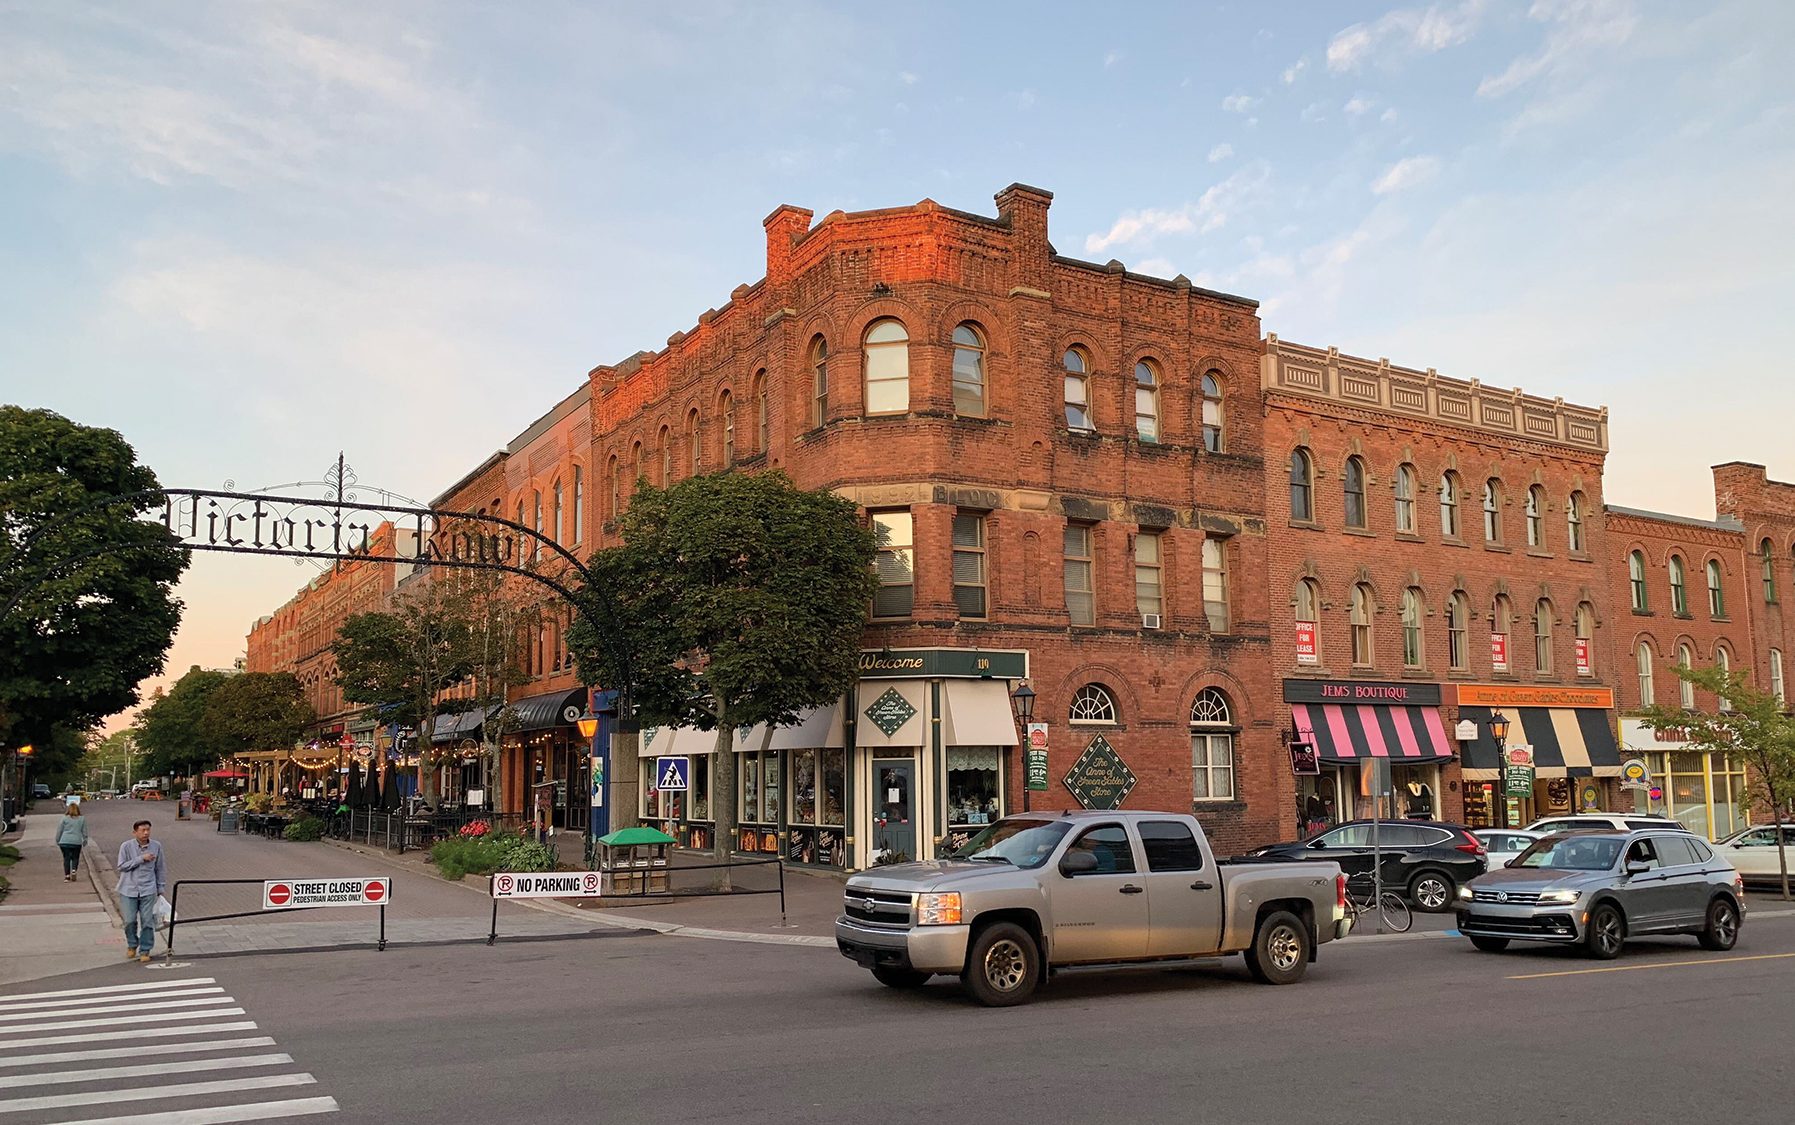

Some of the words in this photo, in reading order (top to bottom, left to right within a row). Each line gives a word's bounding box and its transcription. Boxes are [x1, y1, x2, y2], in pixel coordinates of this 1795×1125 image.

[160, 493, 370, 554] Victoria
[411, 512, 514, 565] Row
[1299, 634, 1310, 642] FOR
[1297, 644, 1313, 653] LEASE
[858, 653, 924, 670] Welcome
[1321, 684, 1350, 697] JEMS
[1355, 686, 1409, 702] BOUTIQUE
[1093, 757, 1108, 768] The
[1086, 767, 1106, 776] Anne
[294, 883, 327, 895] STREET
[329, 882, 362, 893] CLOSED
[517, 879, 532, 892] NO
[535, 878, 580, 892] PARKING
[293, 894, 326, 903] PEDESTRIAN
[327, 894, 348, 902] ACCESS
[348, 893, 361, 901] ONLY
